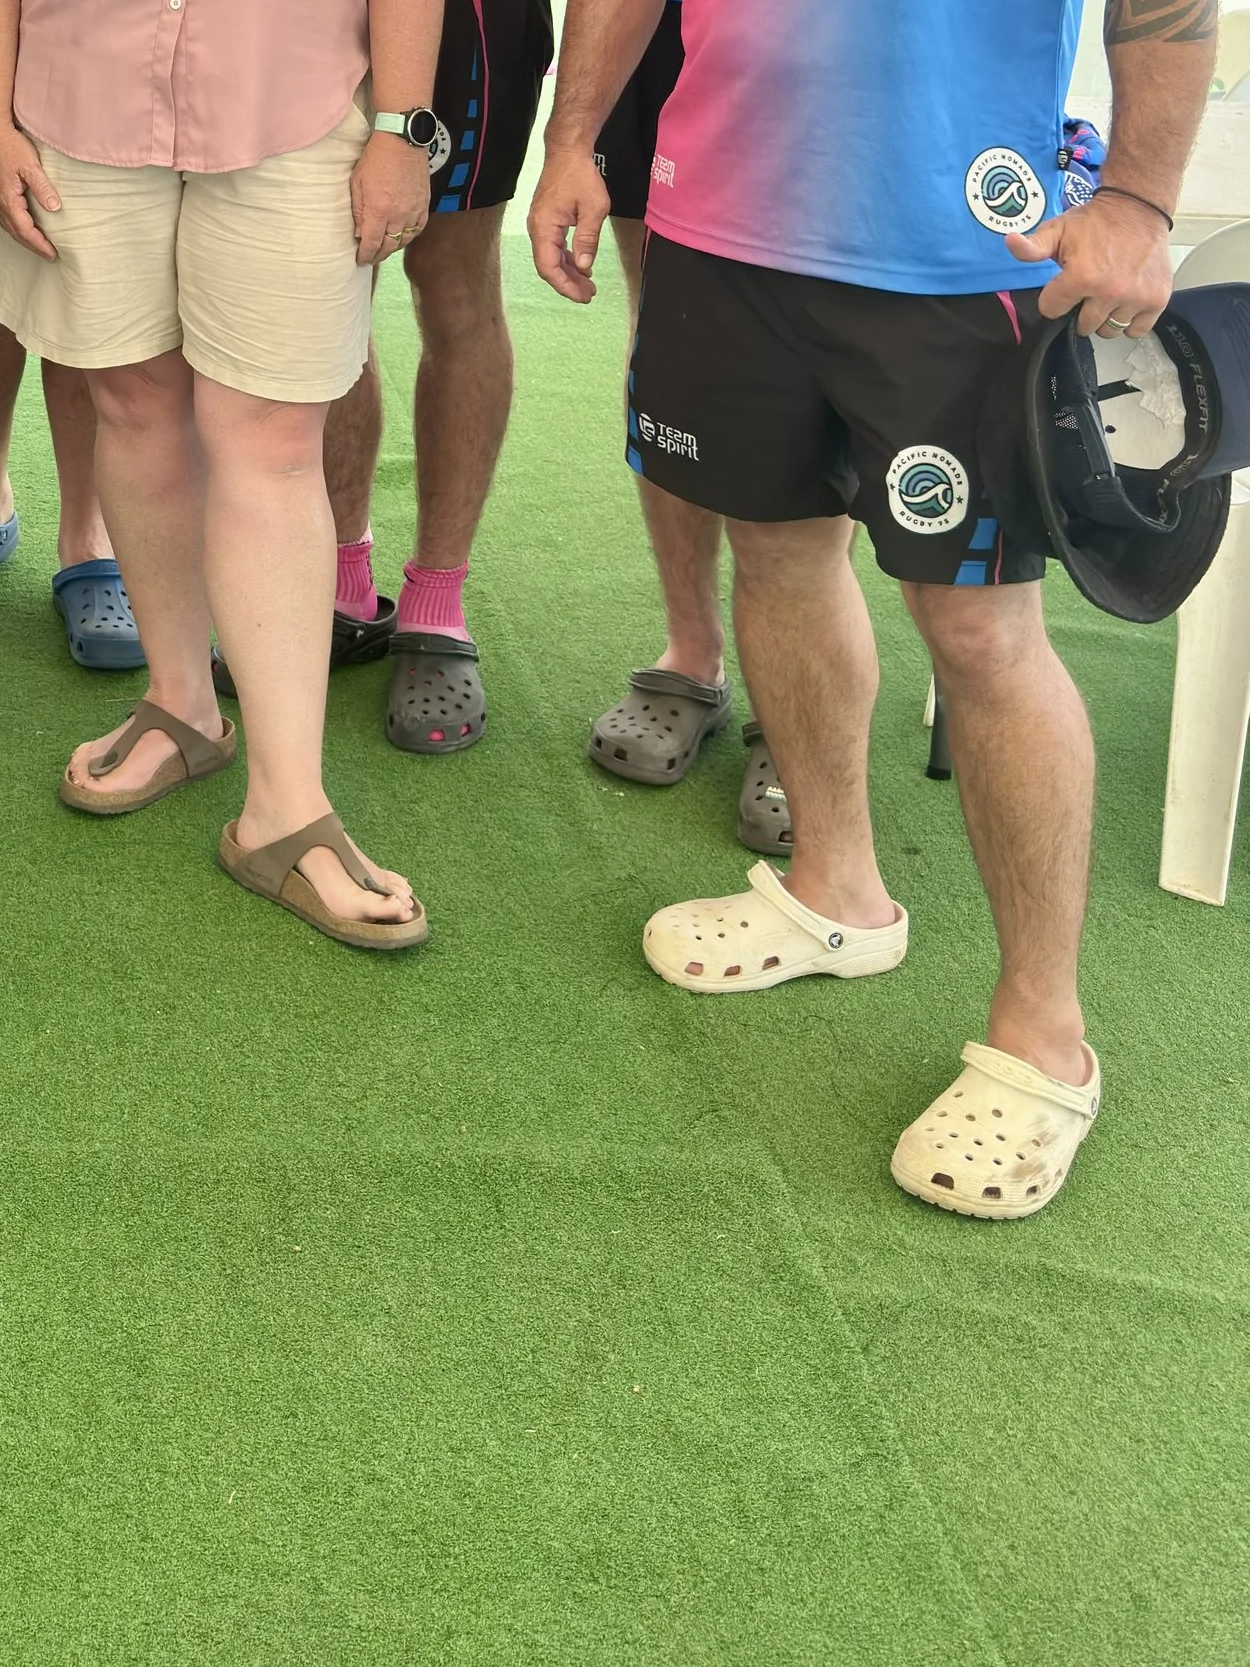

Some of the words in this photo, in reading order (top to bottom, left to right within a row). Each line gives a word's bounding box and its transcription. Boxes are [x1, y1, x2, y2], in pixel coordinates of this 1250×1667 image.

[972, 154, 998, 183] PACIFIC
[1001, 154, 1032, 182] NOMADS
[988, 215, 1019, 228] RUGBY
[1190, 363, 1210, 434] FLEXFIT
[892, 451, 927, 475] PACIFIC
[932, 452, 963, 486] NOMADS
[899, 510, 933, 527] RUGBY
